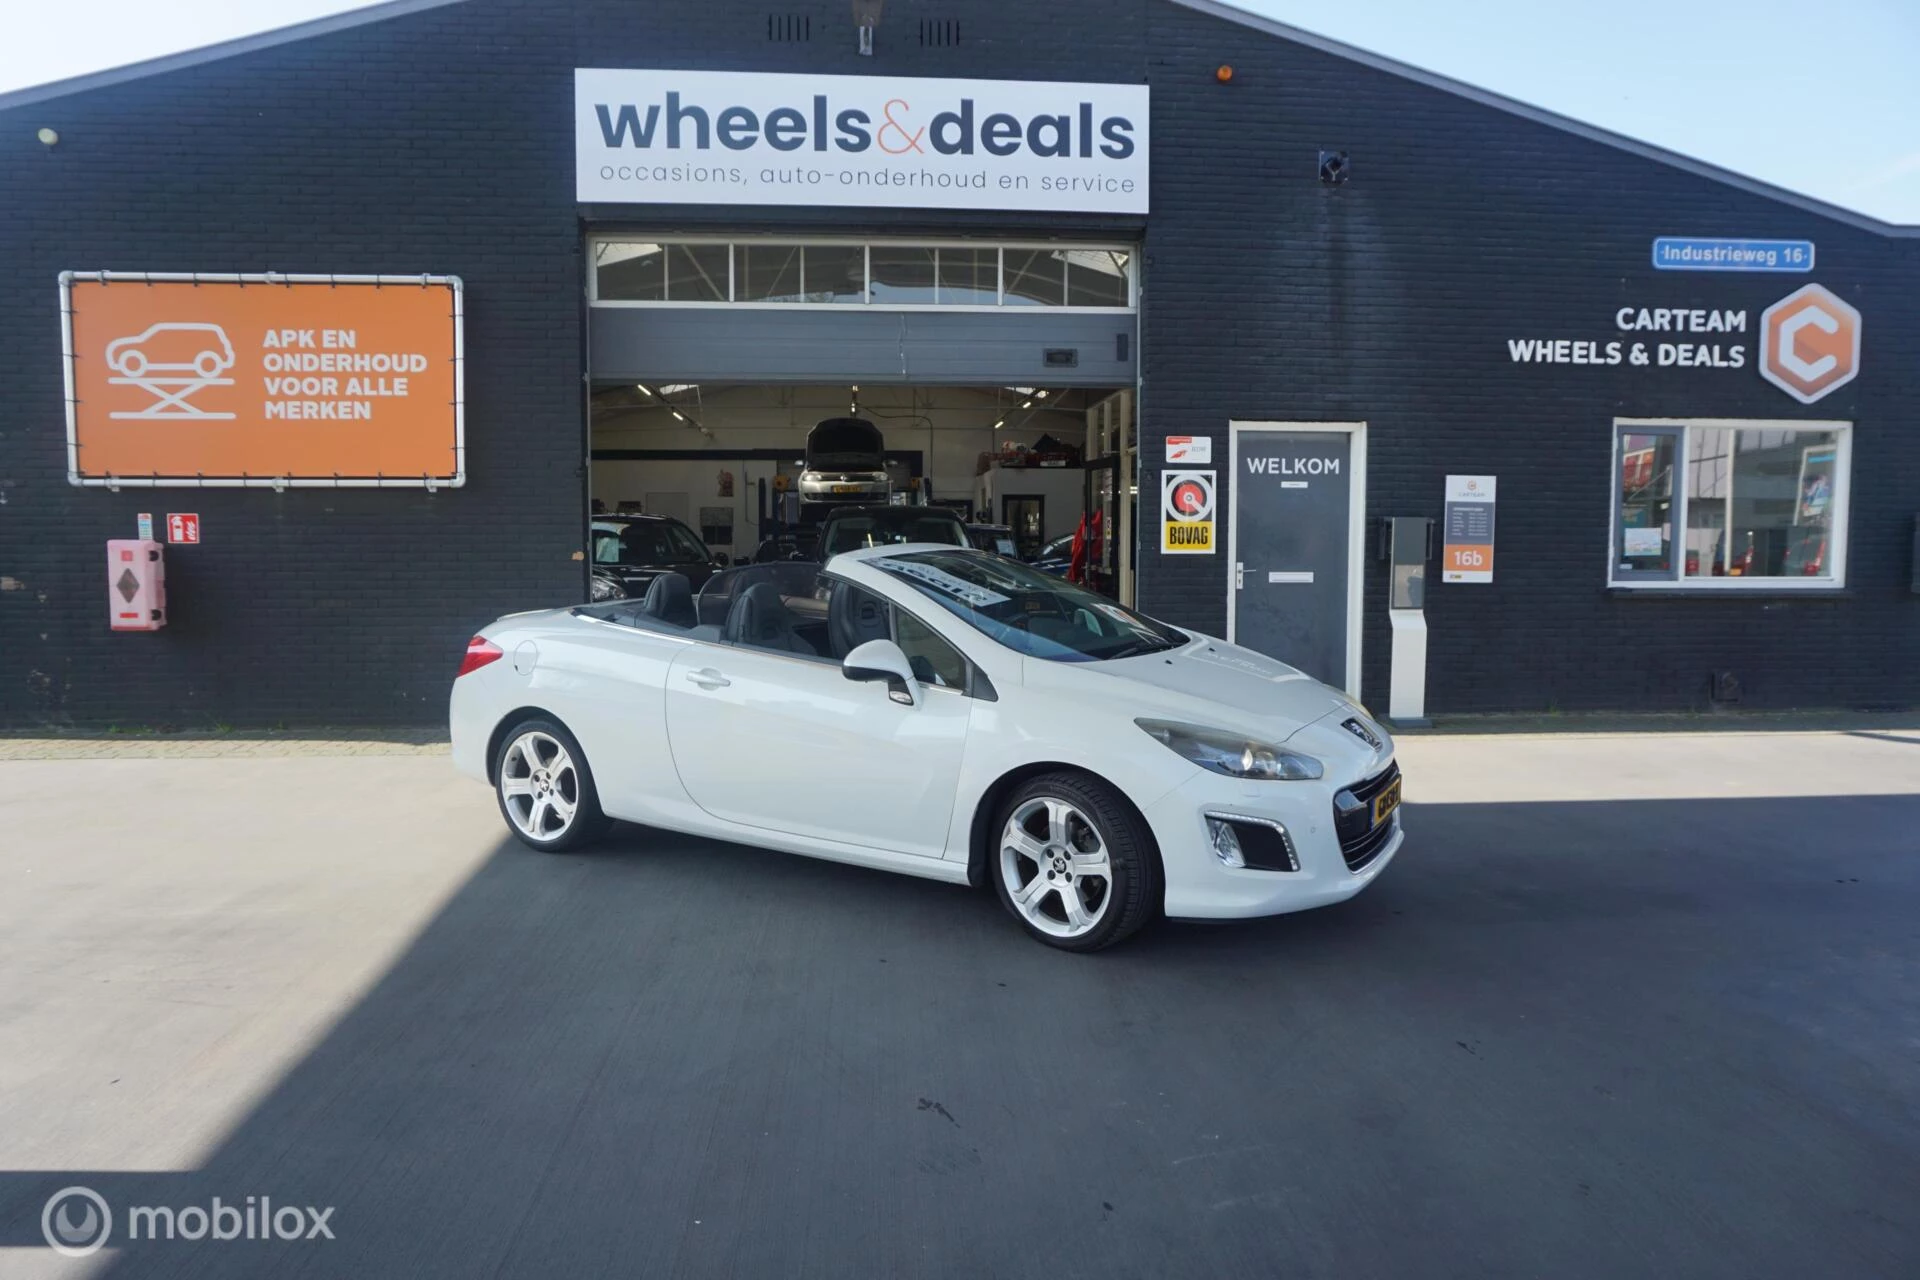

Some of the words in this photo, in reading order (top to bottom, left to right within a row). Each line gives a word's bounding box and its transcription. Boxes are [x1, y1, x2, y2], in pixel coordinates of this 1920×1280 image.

[600, 162, 748, 186] occasions,
[760, 164, 986, 189] auto-onderhoud
[998, 174, 1029, 190] en
[1041, 172, 1135, 193] service
[1664, 244, 1777, 266] Industrieweg
[1784, 247, 1803, 263] 16
[1616, 307, 1747, 333] CARTEAM
[262, 329, 316, 349] APK
[322, 329, 356, 349] EN
[263, 352, 428, 373] ONDERHOUD
[1507, 339, 1622, 365] WHEELS
[1629, 342, 1650, 366] &
[1657, 343, 1745, 368] DEALS
[263, 376, 339, 396] VOOR
[345, 377, 409, 397] ALLE
[264, 400, 372, 420] MERKEN
[1246, 457, 1340, 476] WELKOM
[1169, 526, 1209, 545] BOVAG
[1454, 550, 1483, 567] 16b
